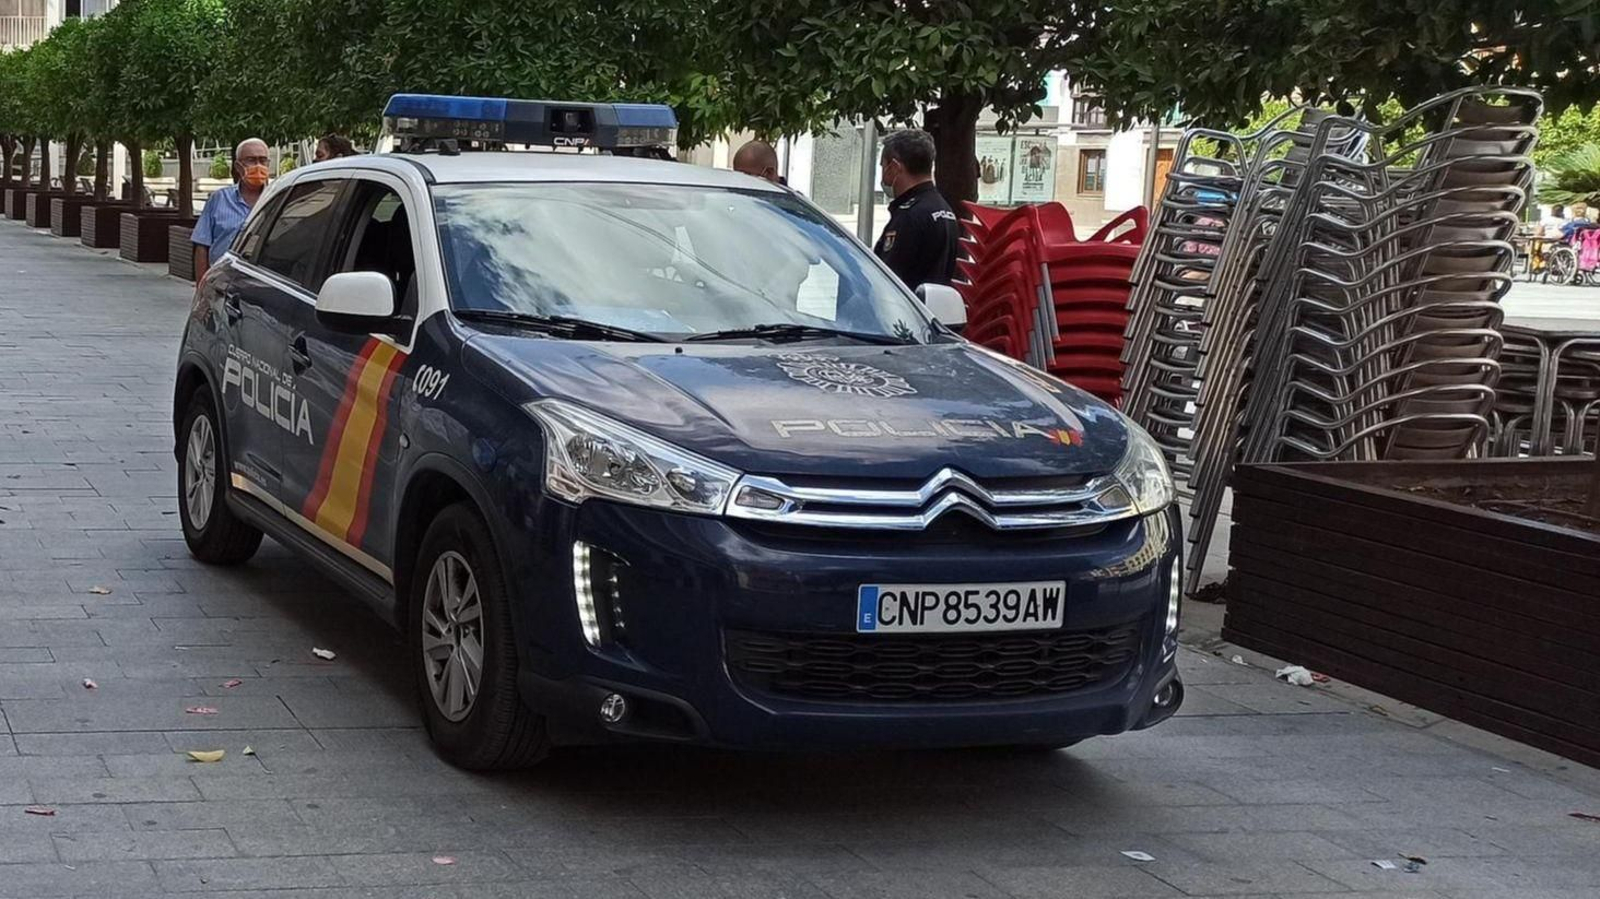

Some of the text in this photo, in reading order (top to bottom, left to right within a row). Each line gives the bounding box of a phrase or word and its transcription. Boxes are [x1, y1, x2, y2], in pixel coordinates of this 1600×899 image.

[282, 372, 293, 387] DE
[864, 587, 1061, 626] E CNP8539AW
